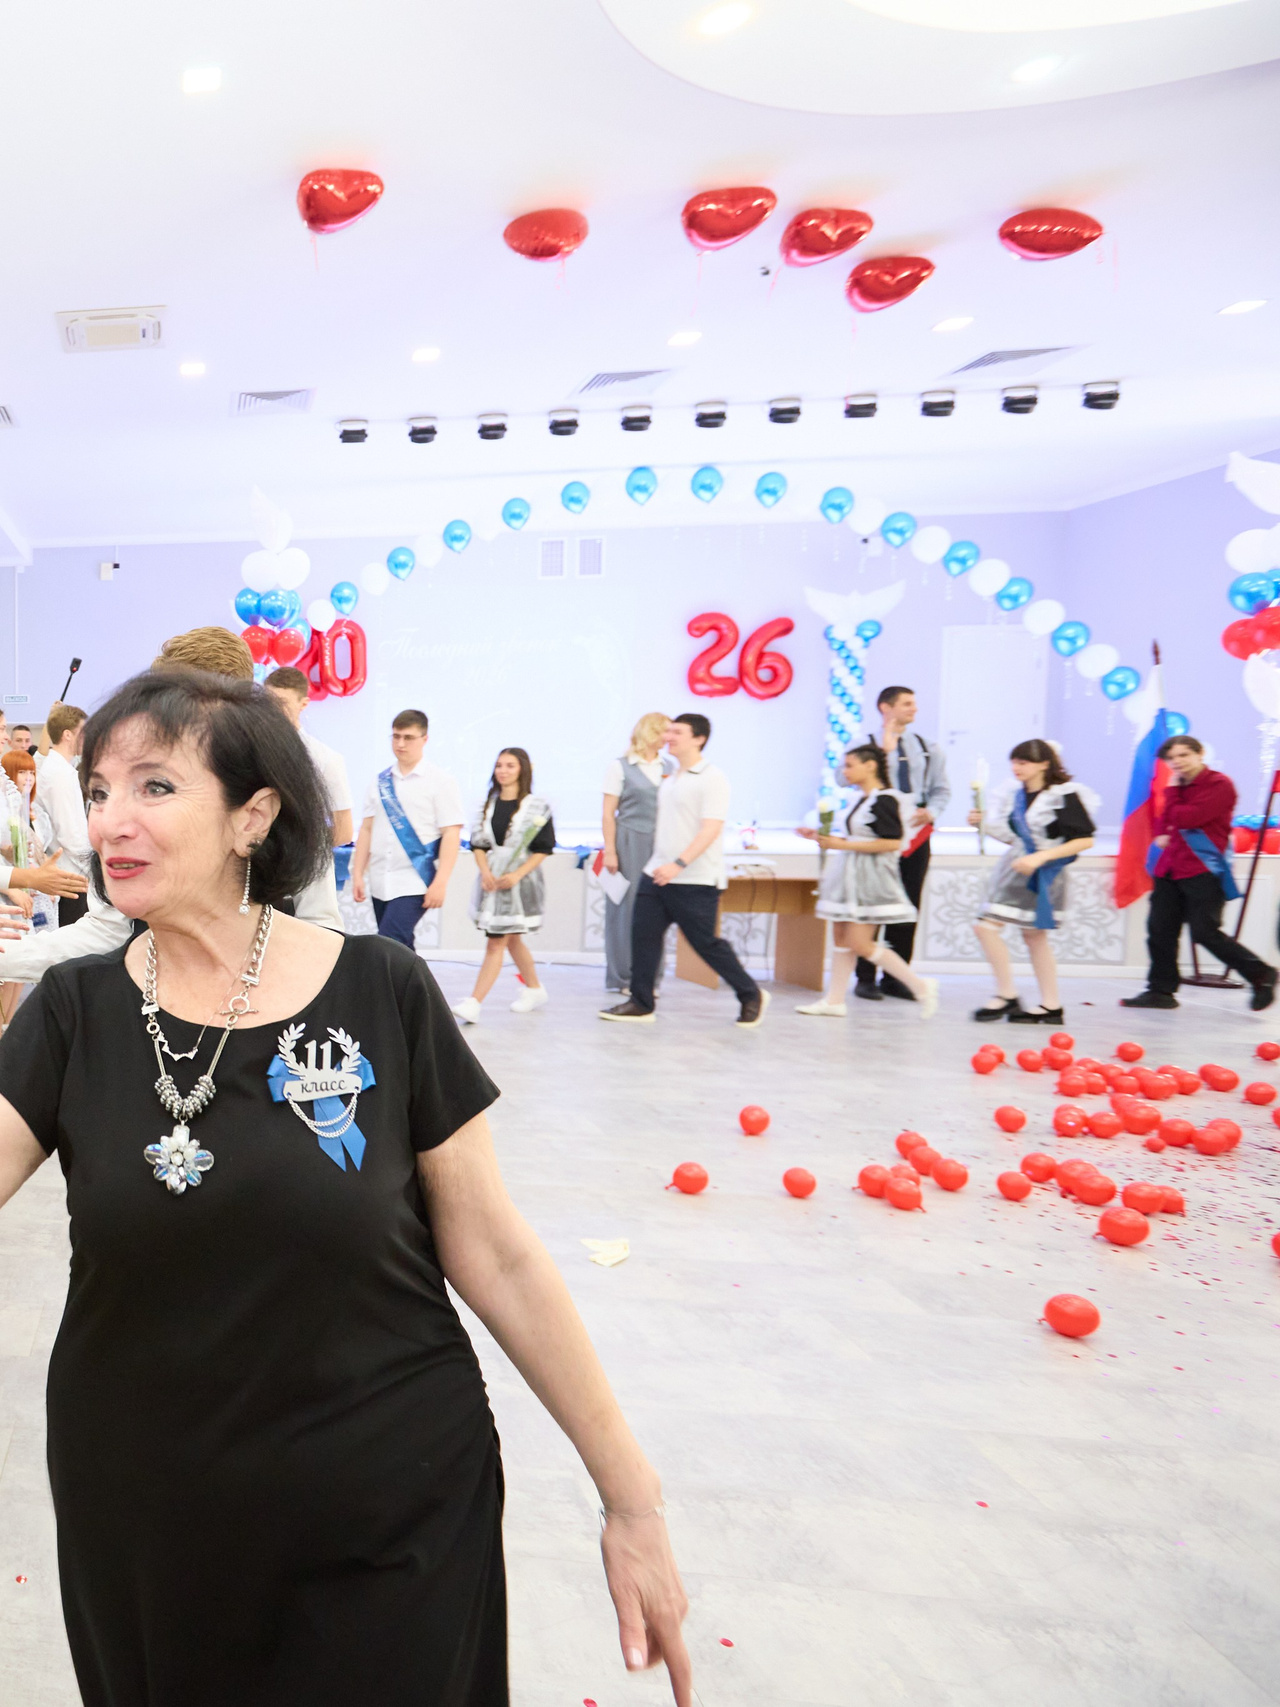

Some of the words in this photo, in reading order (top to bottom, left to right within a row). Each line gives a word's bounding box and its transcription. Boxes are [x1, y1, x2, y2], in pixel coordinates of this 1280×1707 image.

[687, 612, 794, 700] 26
[304, 1039, 332, 1070] 11
[301, 1080, 347, 1093] класс
